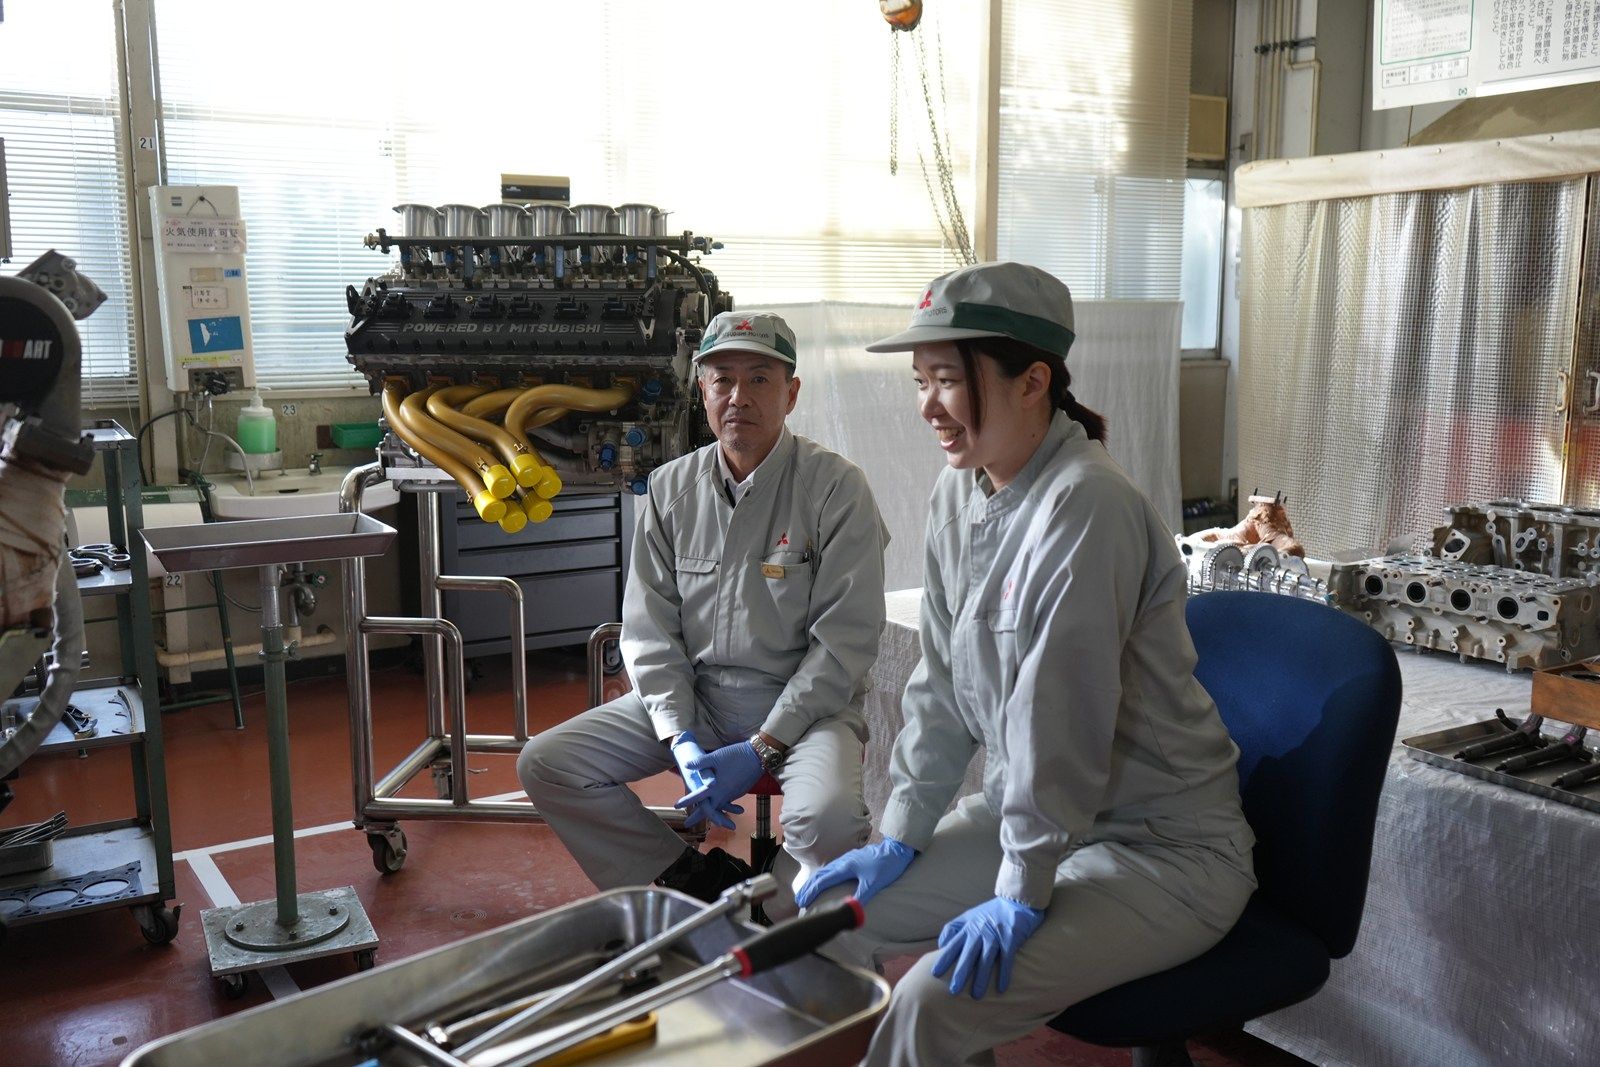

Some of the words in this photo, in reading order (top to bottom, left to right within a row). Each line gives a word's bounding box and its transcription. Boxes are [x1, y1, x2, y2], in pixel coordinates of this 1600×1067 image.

[140, 137, 153, 149] 21
[402, 323, 478, 333] POWERED
[482, 323, 503, 333] BY
[509, 323, 600, 334] MITSUBISHI
[283, 404, 296, 416] 23
[167, 574, 180, 586] 22
